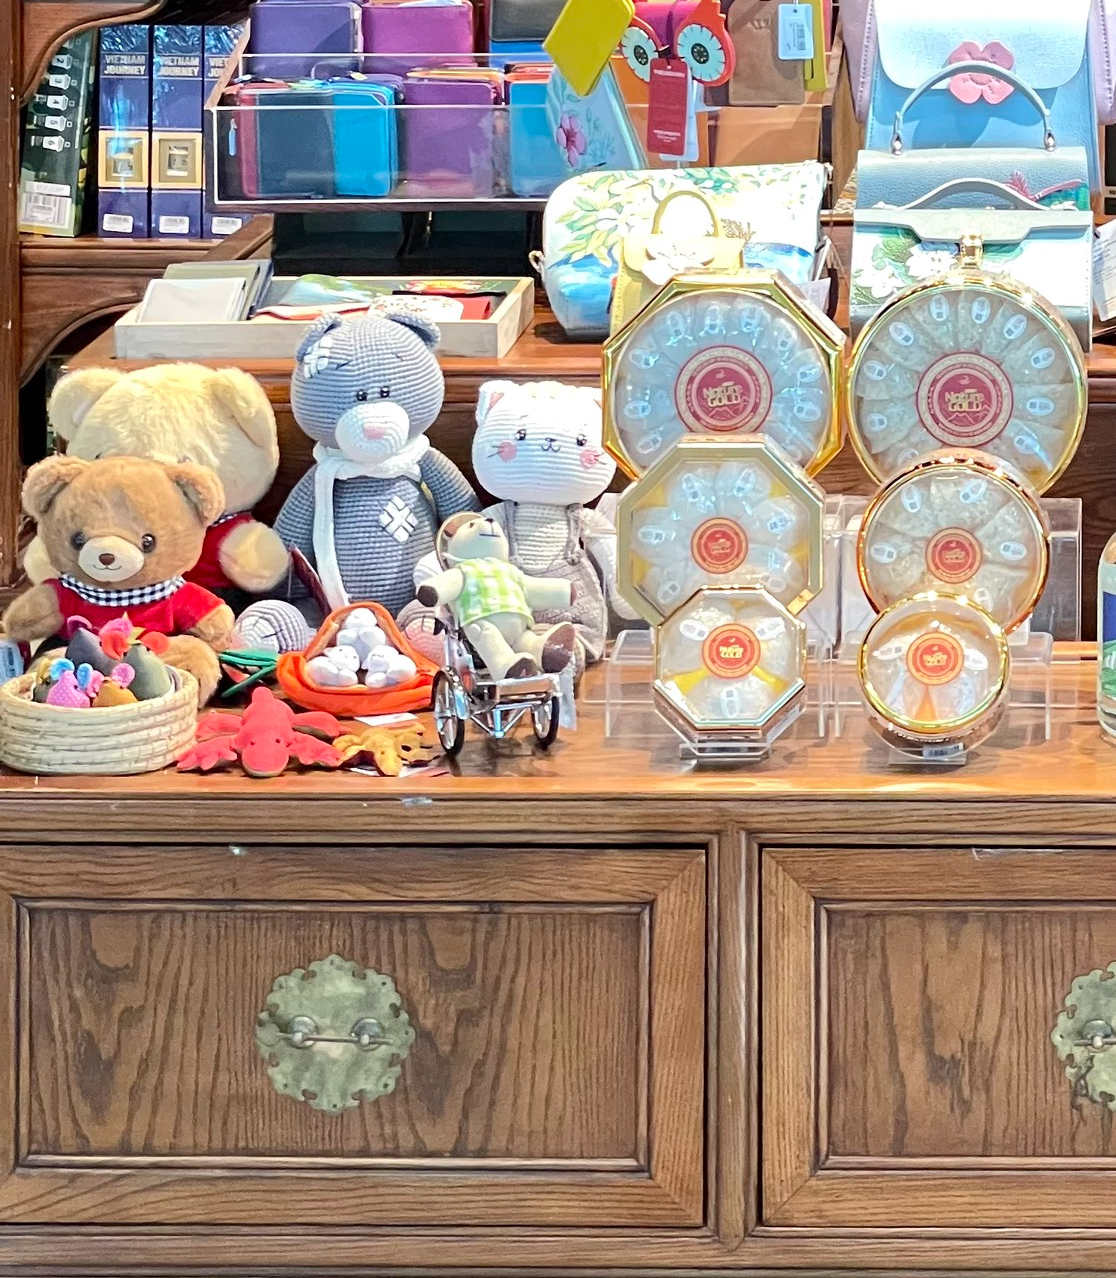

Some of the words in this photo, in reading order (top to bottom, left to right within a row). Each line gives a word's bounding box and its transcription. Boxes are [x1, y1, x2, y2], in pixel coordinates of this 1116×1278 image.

[104, 55, 146, 65] VIETNAM
[104, 65, 146, 75] JOURNEY
[948, 401, 982, 412] GOLD
